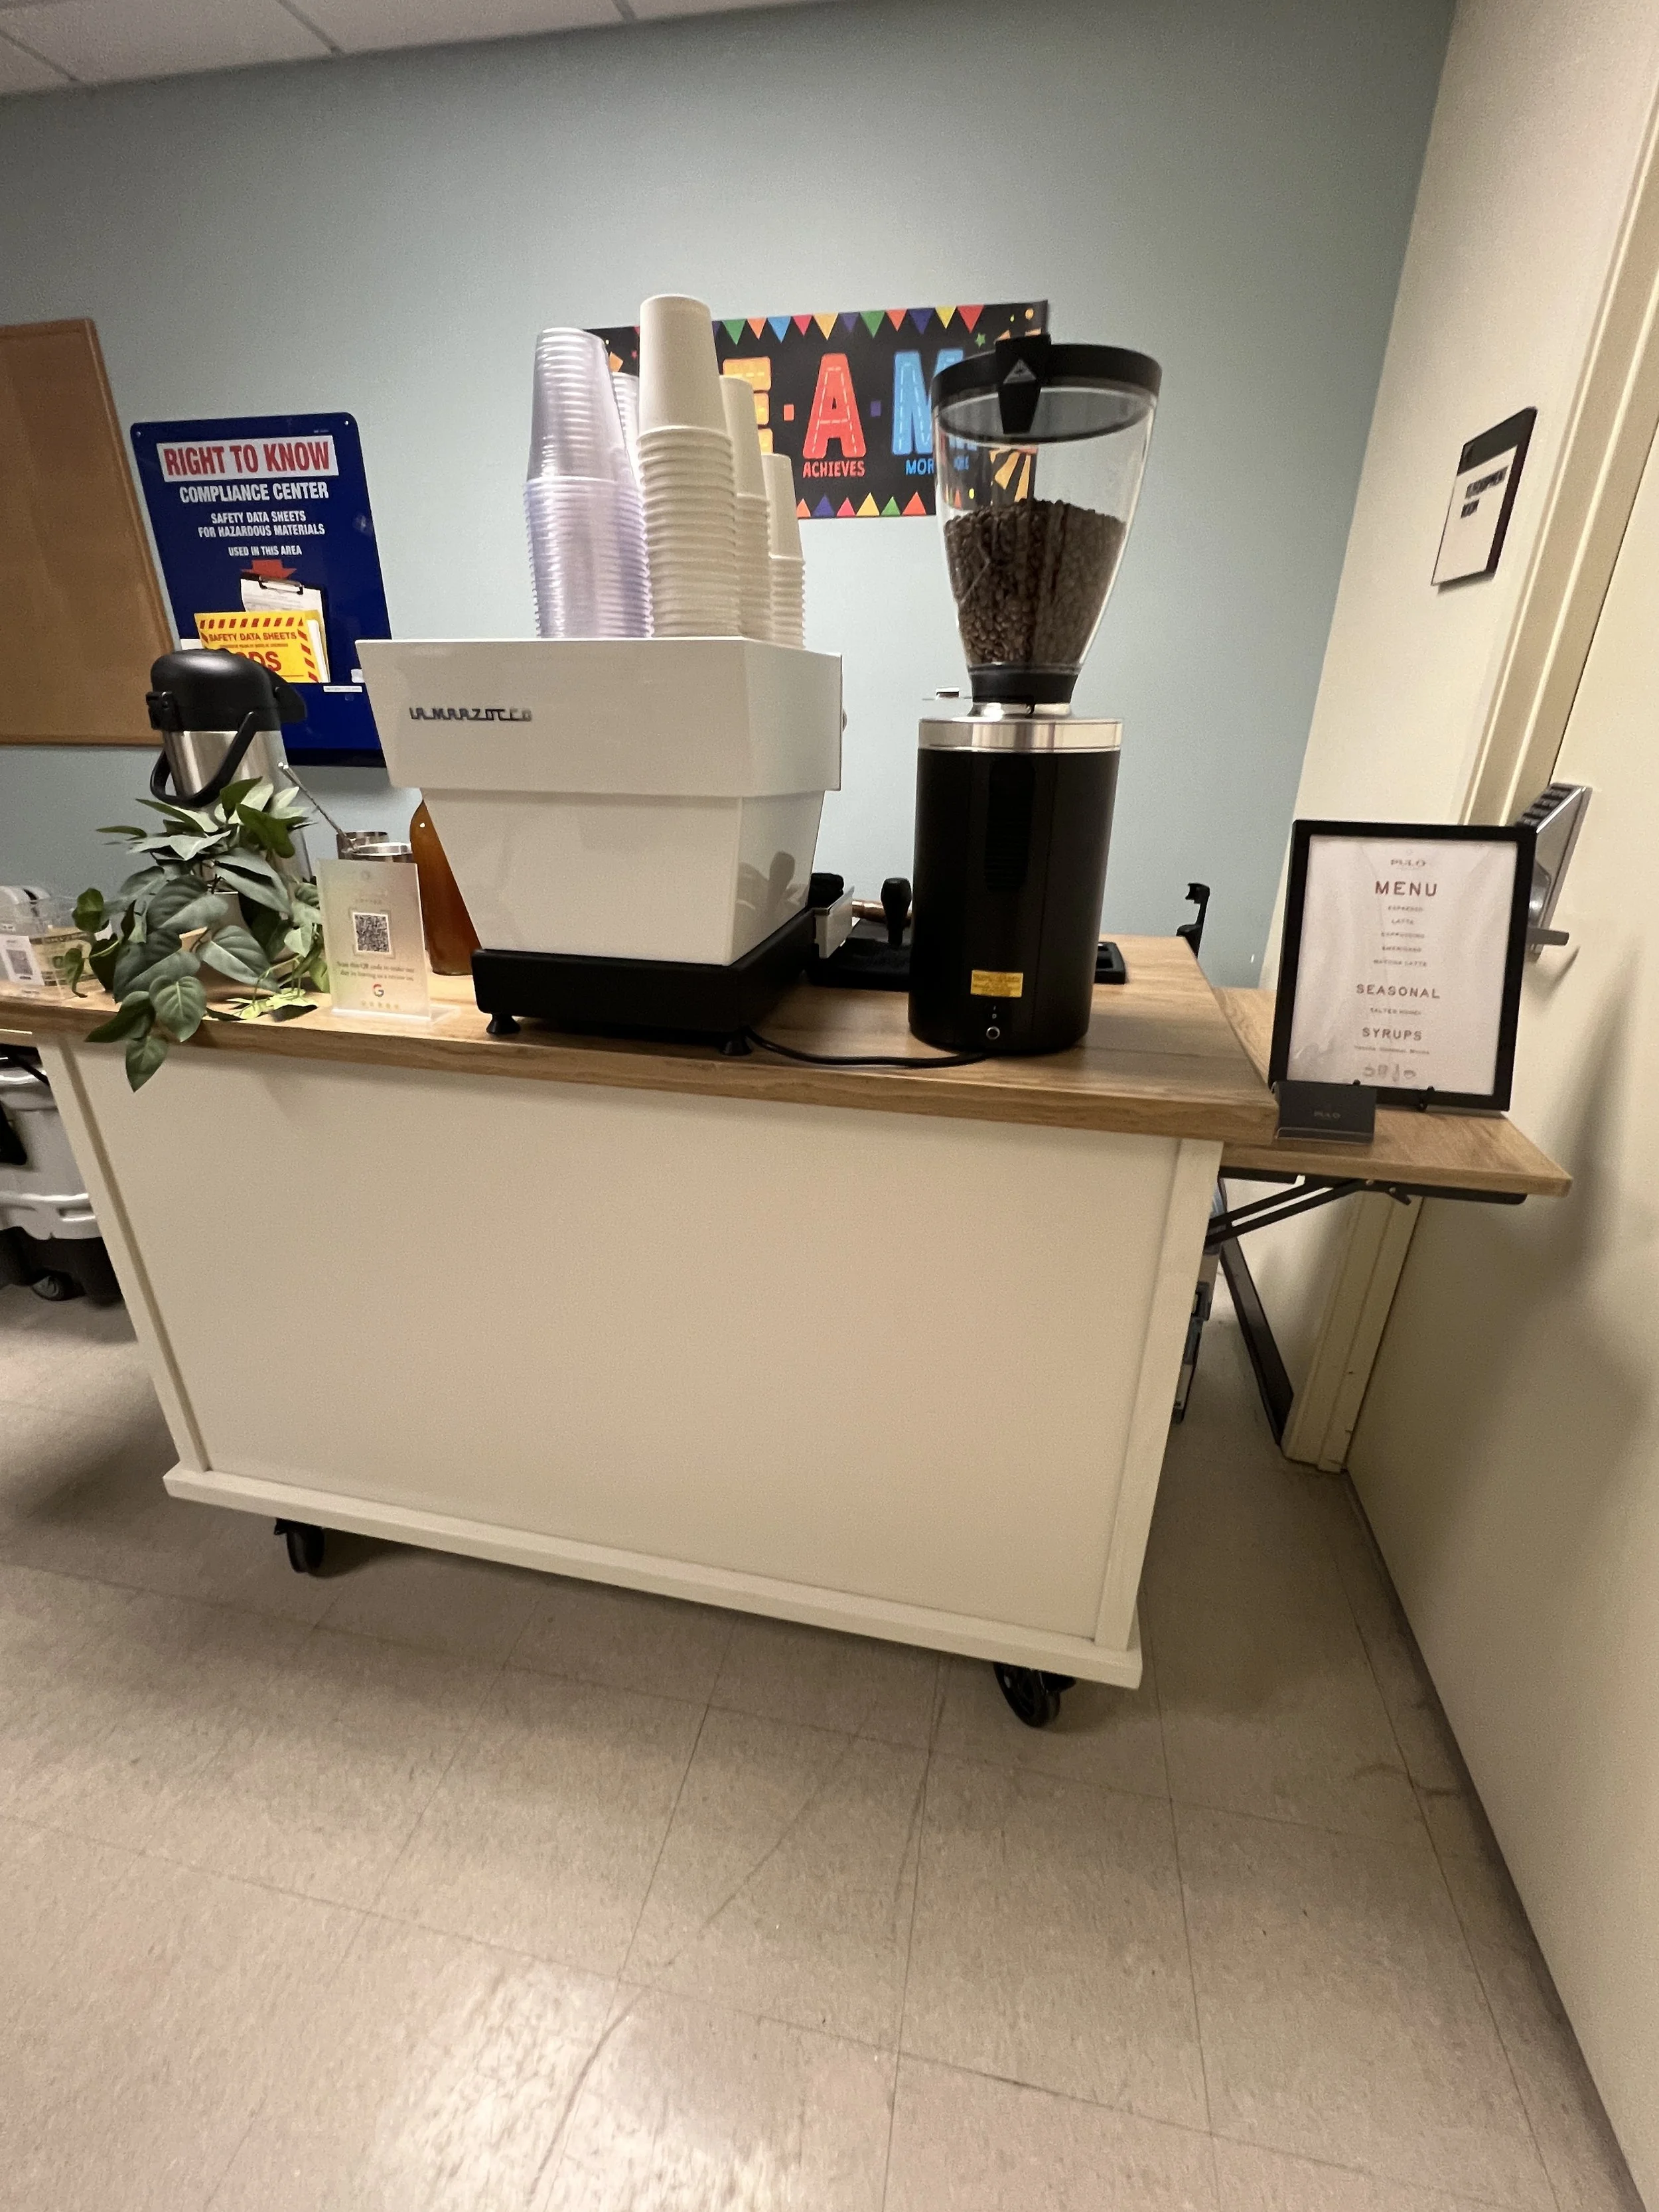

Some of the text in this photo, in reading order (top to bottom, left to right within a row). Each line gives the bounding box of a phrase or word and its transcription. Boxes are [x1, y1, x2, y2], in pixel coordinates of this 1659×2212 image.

[163, 441, 330, 476] RIGHT TO KNOW
[802, 461, 865, 479] ACHIEVES
[905, 458, 934, 476] MOR
[179, 482, 329, 503] COMPLIANCE CENTER
[211, 510, 307, 524] SAFETY DATA SHEETS
[198, 524, 325, 538] FOR HAZARDOUS MATERIALS
[228, 546, 303, 556] USED IN THIS AREA
[208, 632, 237, 642] SAFETY
[240, 632, 260, 641] DATA
[1375, 880, 1438, 897] MENU
[1356, 984, 1441, 999] SEASONAL
[1362, 1027, 1422, 1041] SYRUPS
